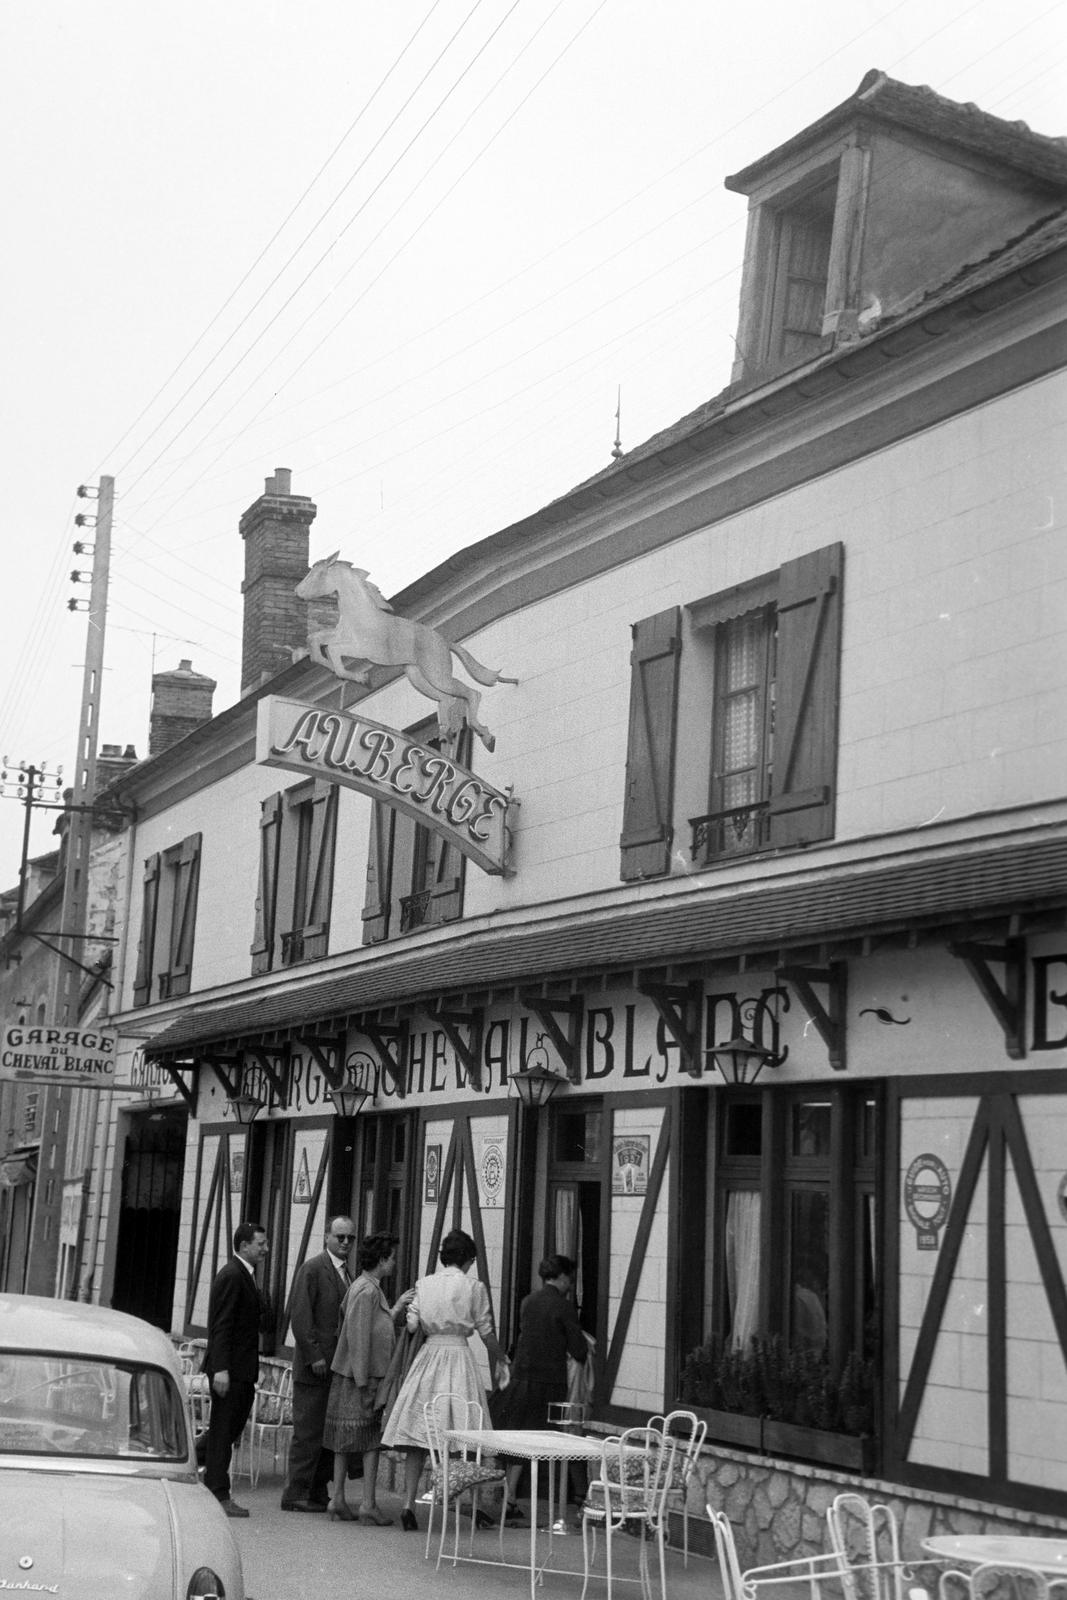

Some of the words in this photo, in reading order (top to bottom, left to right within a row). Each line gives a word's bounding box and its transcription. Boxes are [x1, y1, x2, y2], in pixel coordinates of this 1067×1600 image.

[271, 709, 508, 841] AUBERGE
[6, 1028, 115, 1054] GARAGE
[585, 986, 791, 1083] BLANC
[2, 1050, 60, 1072] CHEVAL
[63, 1055, 114, 1074] BLANC
[50, 1046, 69, 1056] DU
